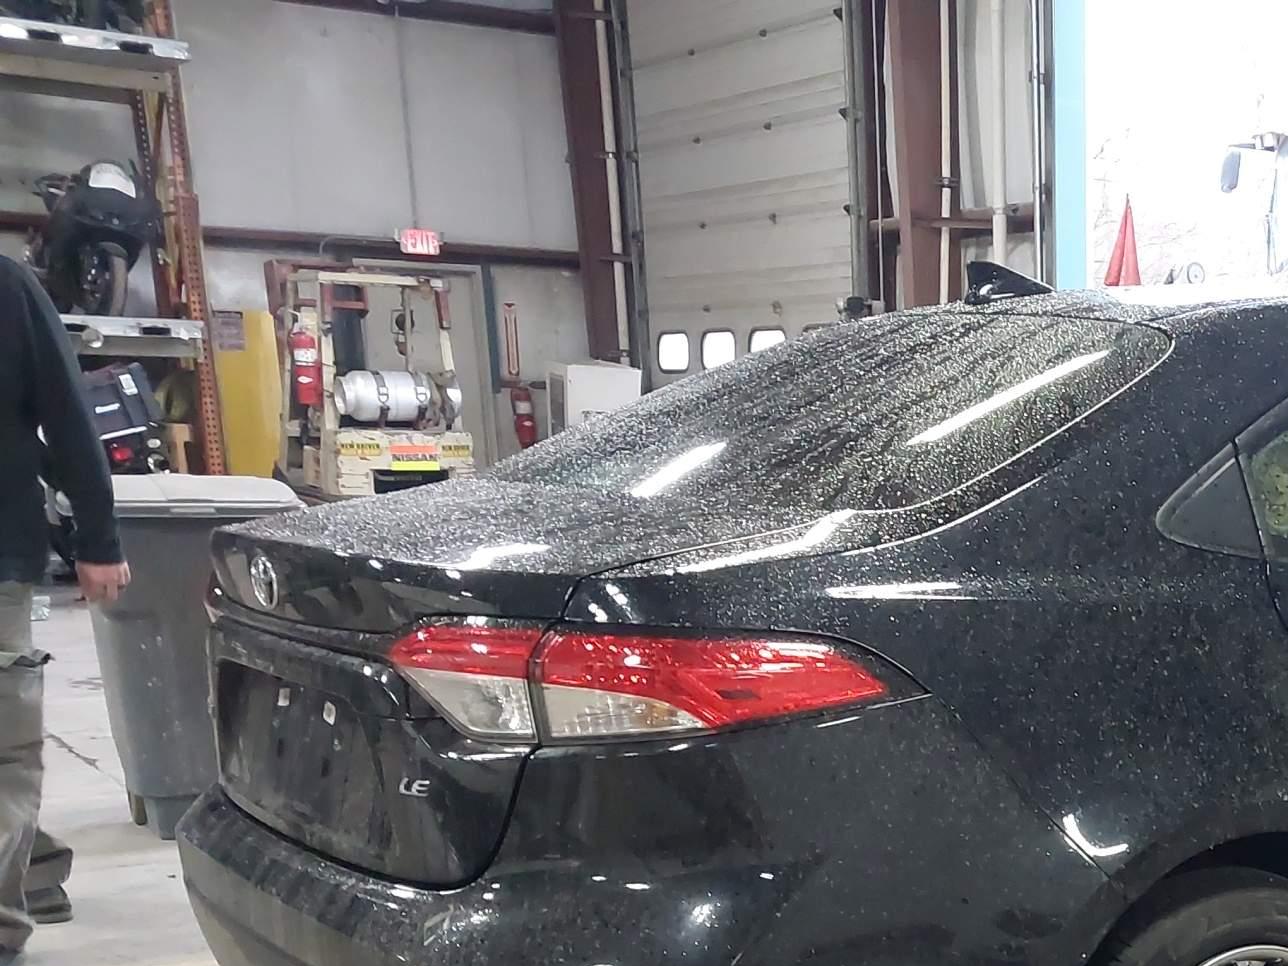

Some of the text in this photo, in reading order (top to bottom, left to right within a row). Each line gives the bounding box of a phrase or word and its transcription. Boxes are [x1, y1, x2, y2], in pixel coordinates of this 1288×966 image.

[405, 229, 437, 254] EXIT
[391, 453, 438, 462] NISSAN
[398, 777, 431, 797] LE
